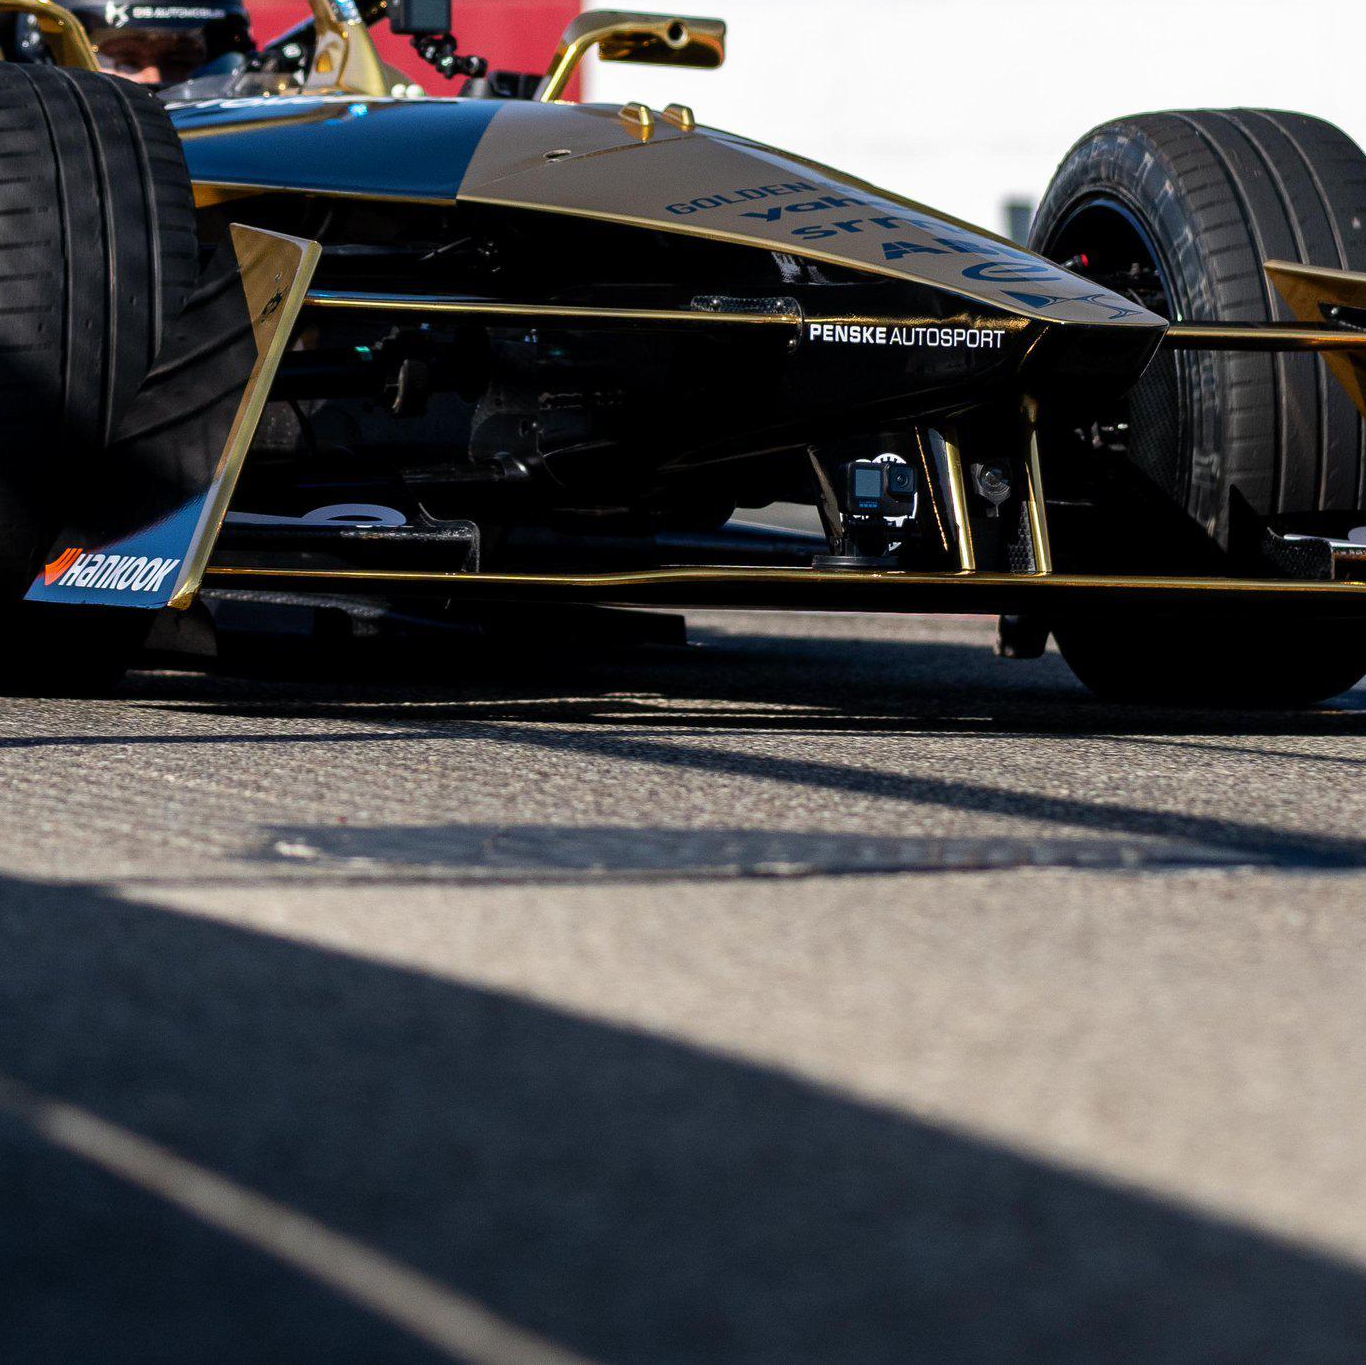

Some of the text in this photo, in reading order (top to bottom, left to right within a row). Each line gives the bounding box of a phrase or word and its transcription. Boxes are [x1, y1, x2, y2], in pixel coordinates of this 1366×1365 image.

[665, 181, 818, 215] GOLDEN
[809, 323, 1006, 348] PENSKE AUTOSPORT
[58, 553, 181, 592] Hankook
